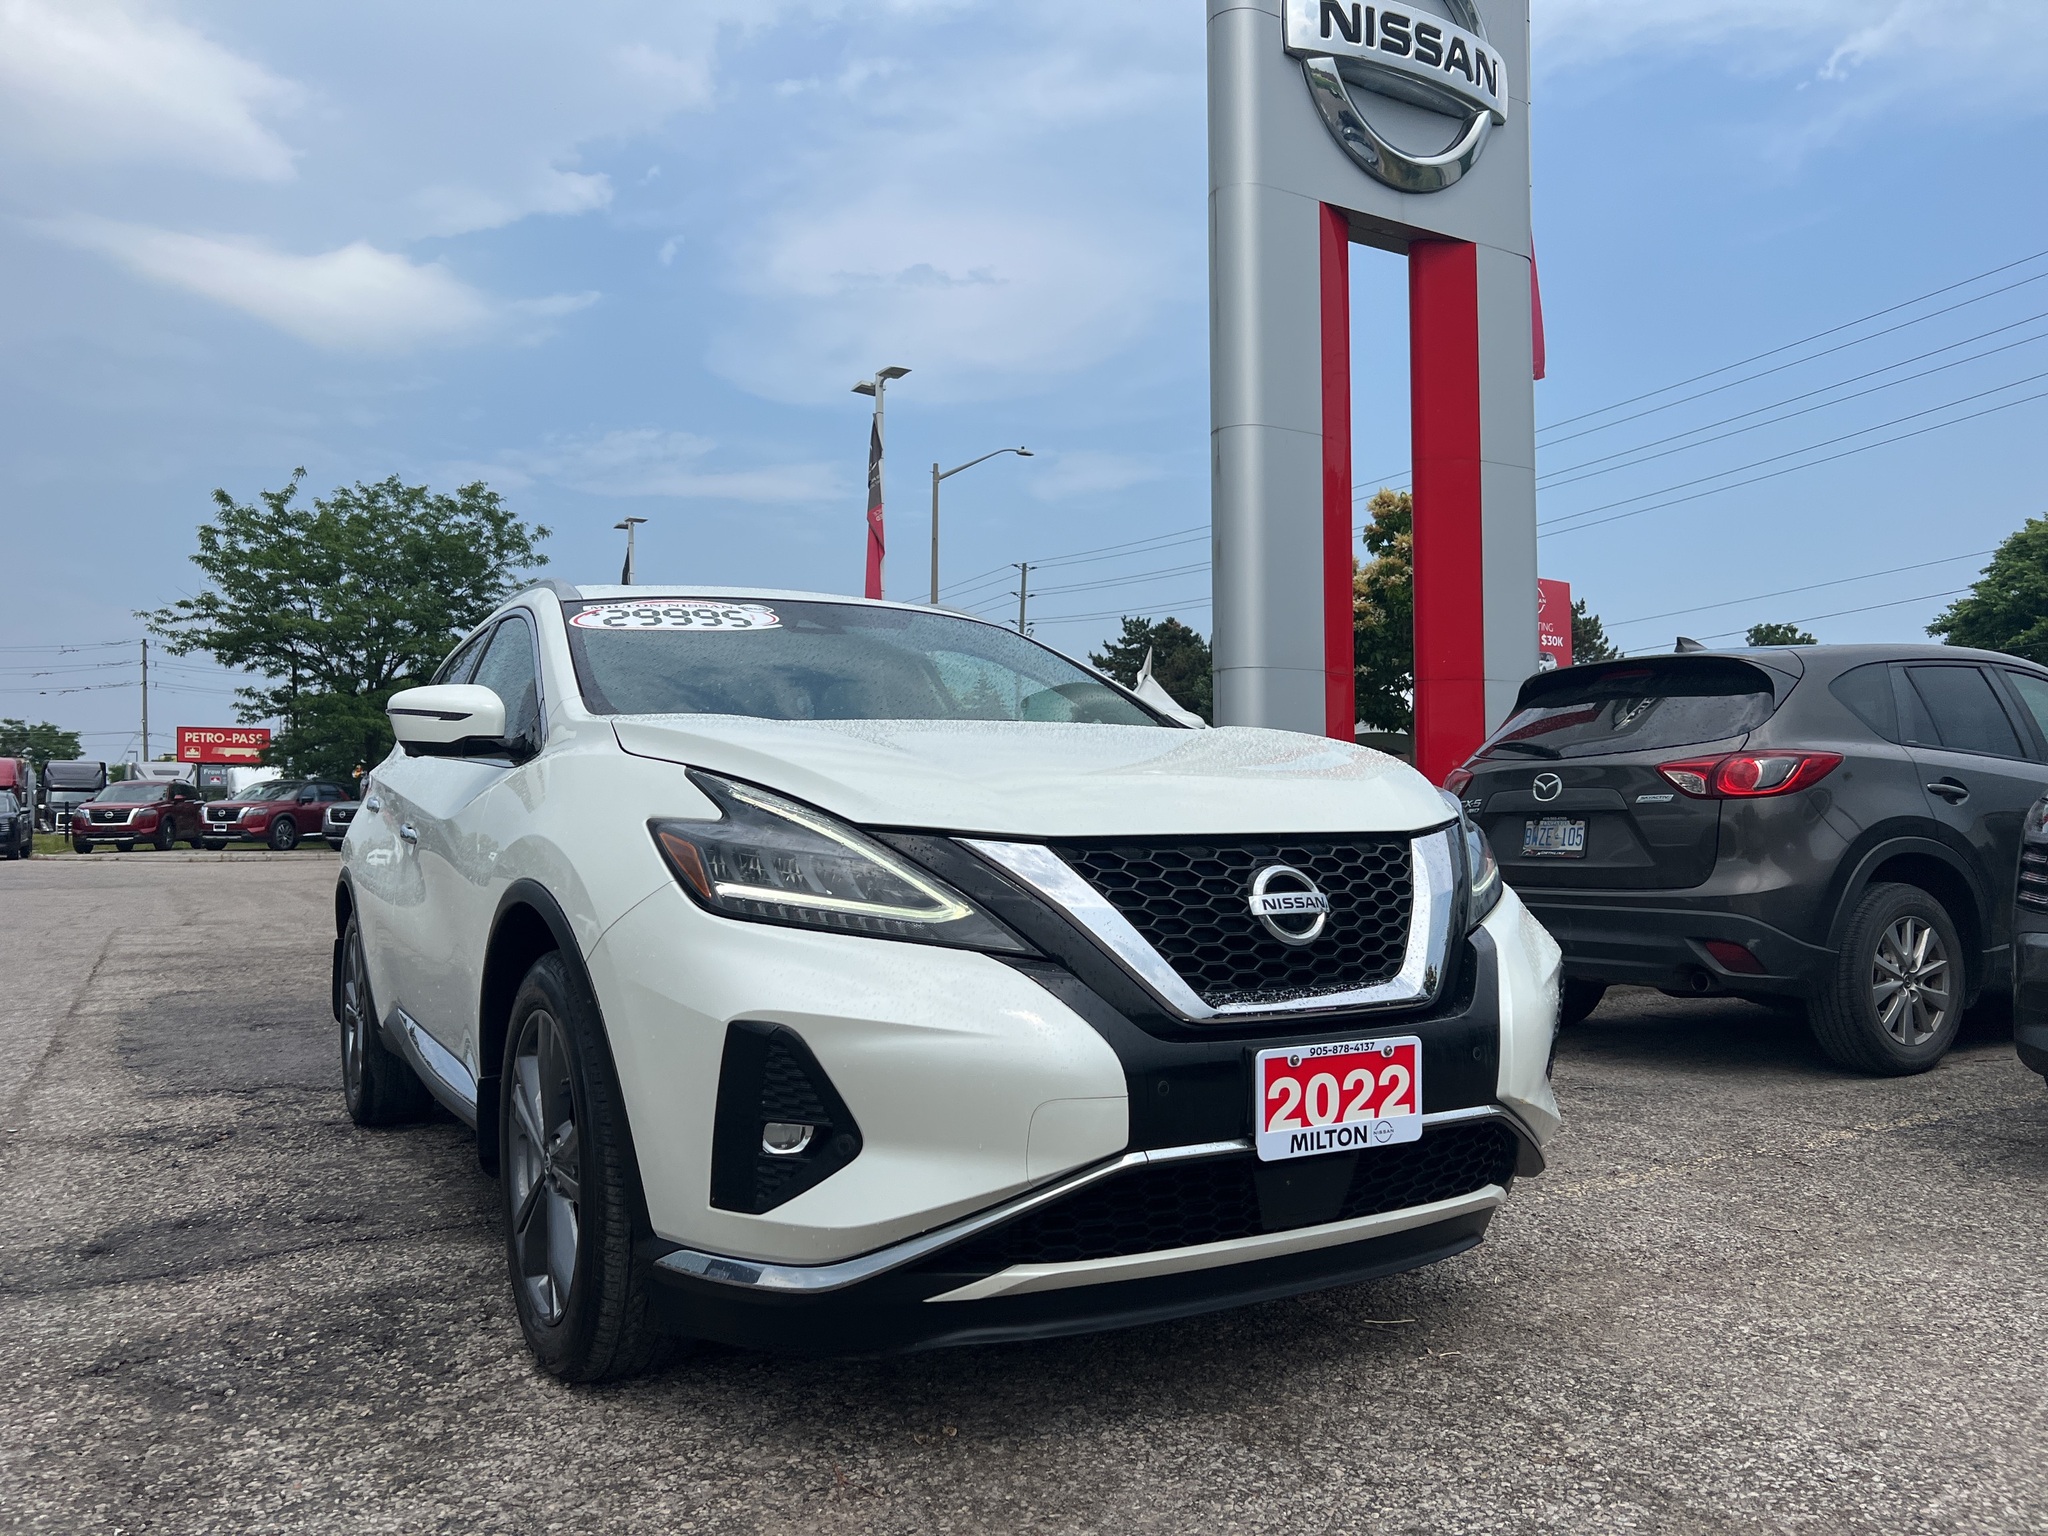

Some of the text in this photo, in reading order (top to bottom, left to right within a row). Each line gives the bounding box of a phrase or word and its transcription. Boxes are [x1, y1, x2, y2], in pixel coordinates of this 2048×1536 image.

[1320, 1, 1498, 97] NISSAN
[1541, 633, 1563, 647] $30K
[1262, 897, 1328, 910] NISSAN
[1309, 1042, 1375, 1057] 905-878-4137
[1267, 1064, 1411, 1133] 2022
[1290, 1125, 1395, 1153] MILTON NISSAN
